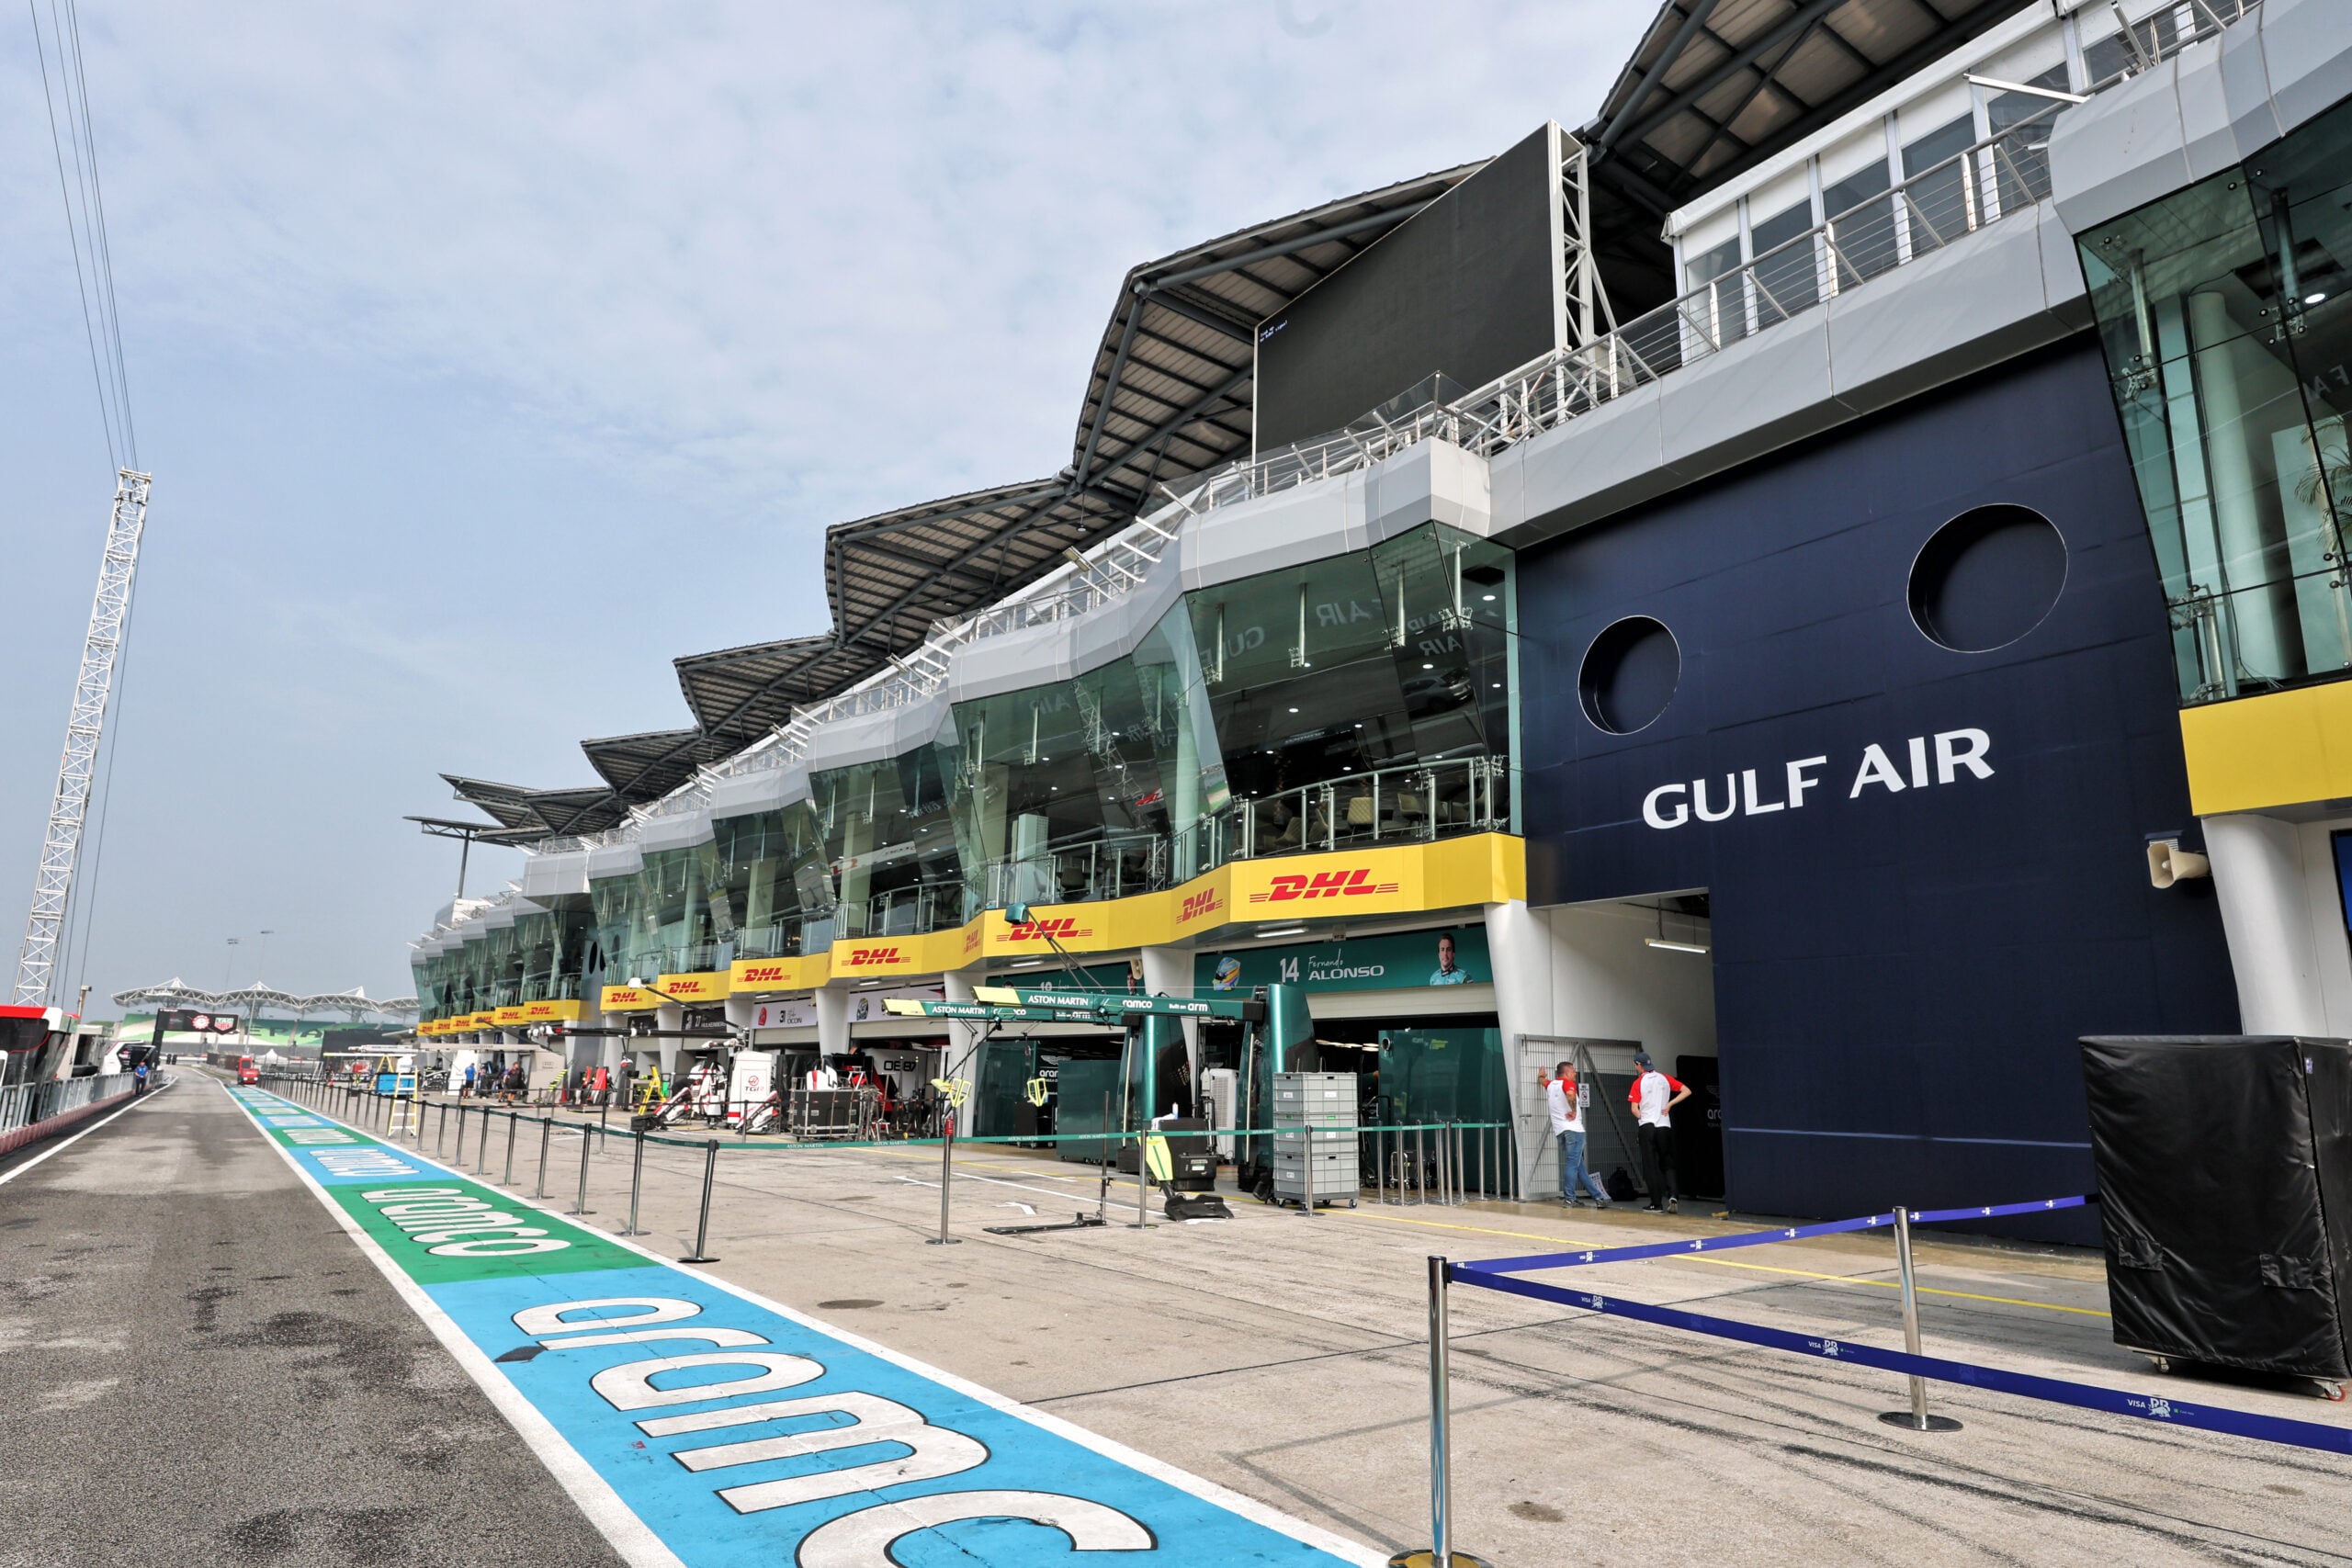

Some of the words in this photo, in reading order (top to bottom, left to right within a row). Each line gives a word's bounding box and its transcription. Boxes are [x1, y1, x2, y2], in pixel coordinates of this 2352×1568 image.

[1642, 755, 1827, 829] GULF
[1849, 728, 1996, 798] AIR
[1268, 868, 1377, 902] DHL
[1182, 887, 1216, 922] DHL
[1009, 918, 1080, 942] DHL
[851, 947, 901, 965] DHL
[743, 967, 783, 982] DHL
[1279, 956, 1300, 983] 14
[1308, 964, 1385, 981] ALONSO
[668, 981, 700, 994] DHL
[610, 992, 638, 1003] DHL
[1028, 995, 1057, 1004] ASTON
[1057, 996, 1089, 1006] MARTIN
[530, 1006, 551, 1015] DHL
[932, 1006, 958, 1014] ASTON
[959, 1006, 986, 1015] MARTIN
[1123, 999, 1153, 1010] ramco
[1187, 1002, 1208, 1012] arm
[502, 1011, 519, 1020] DHL
[359, 1187, 571, 1258] aramco
[1808, 1340, 1821, 1348] VISA
[2127, 1398, 2146, 1409] VISA
